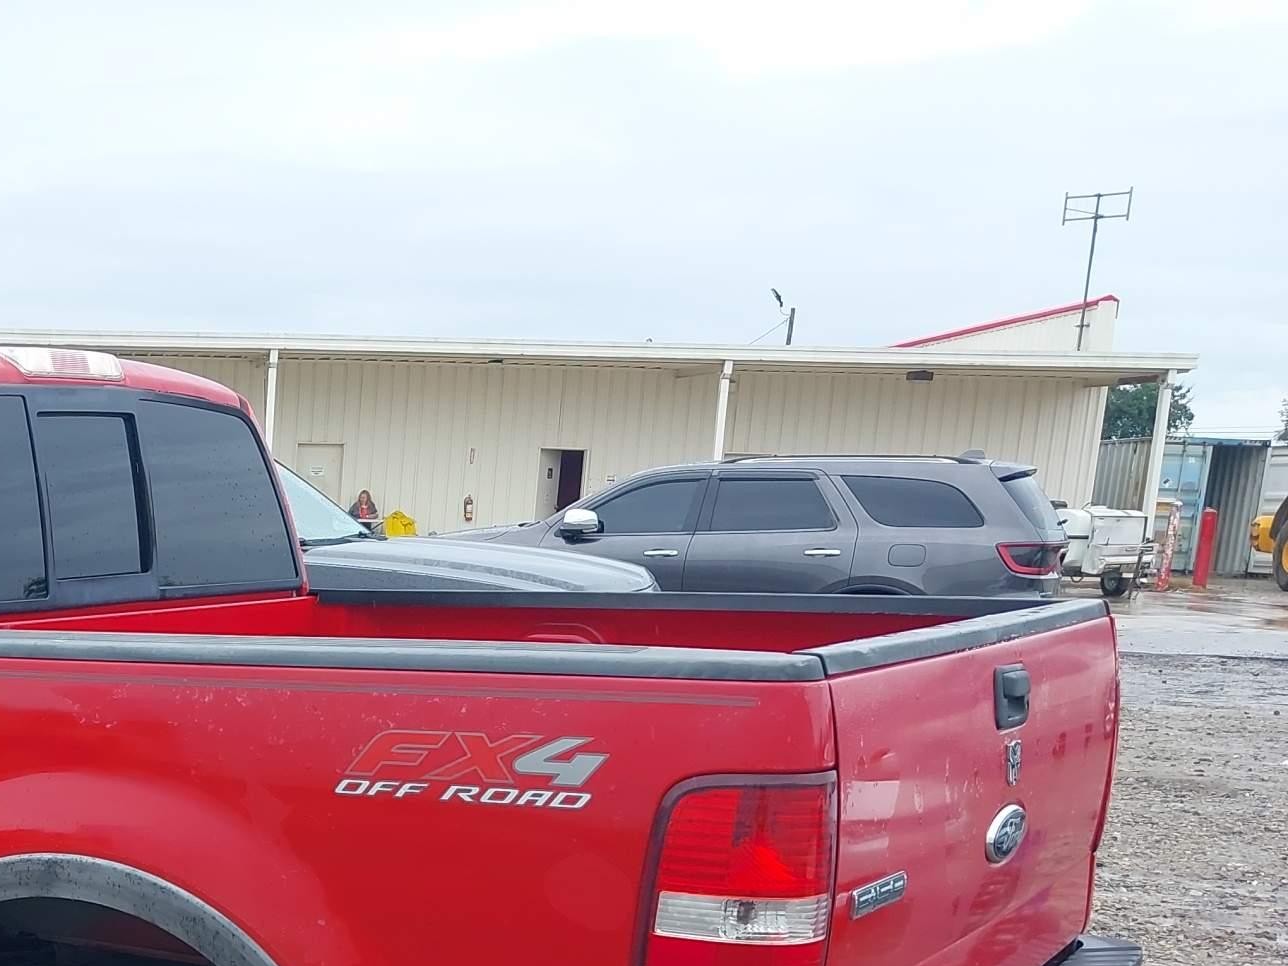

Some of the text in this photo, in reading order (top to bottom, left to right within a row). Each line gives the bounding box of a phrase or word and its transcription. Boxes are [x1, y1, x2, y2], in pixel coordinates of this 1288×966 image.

[344, 729, 610, 786] FX4
[334, 779, 592, 809] OFF ROAD
